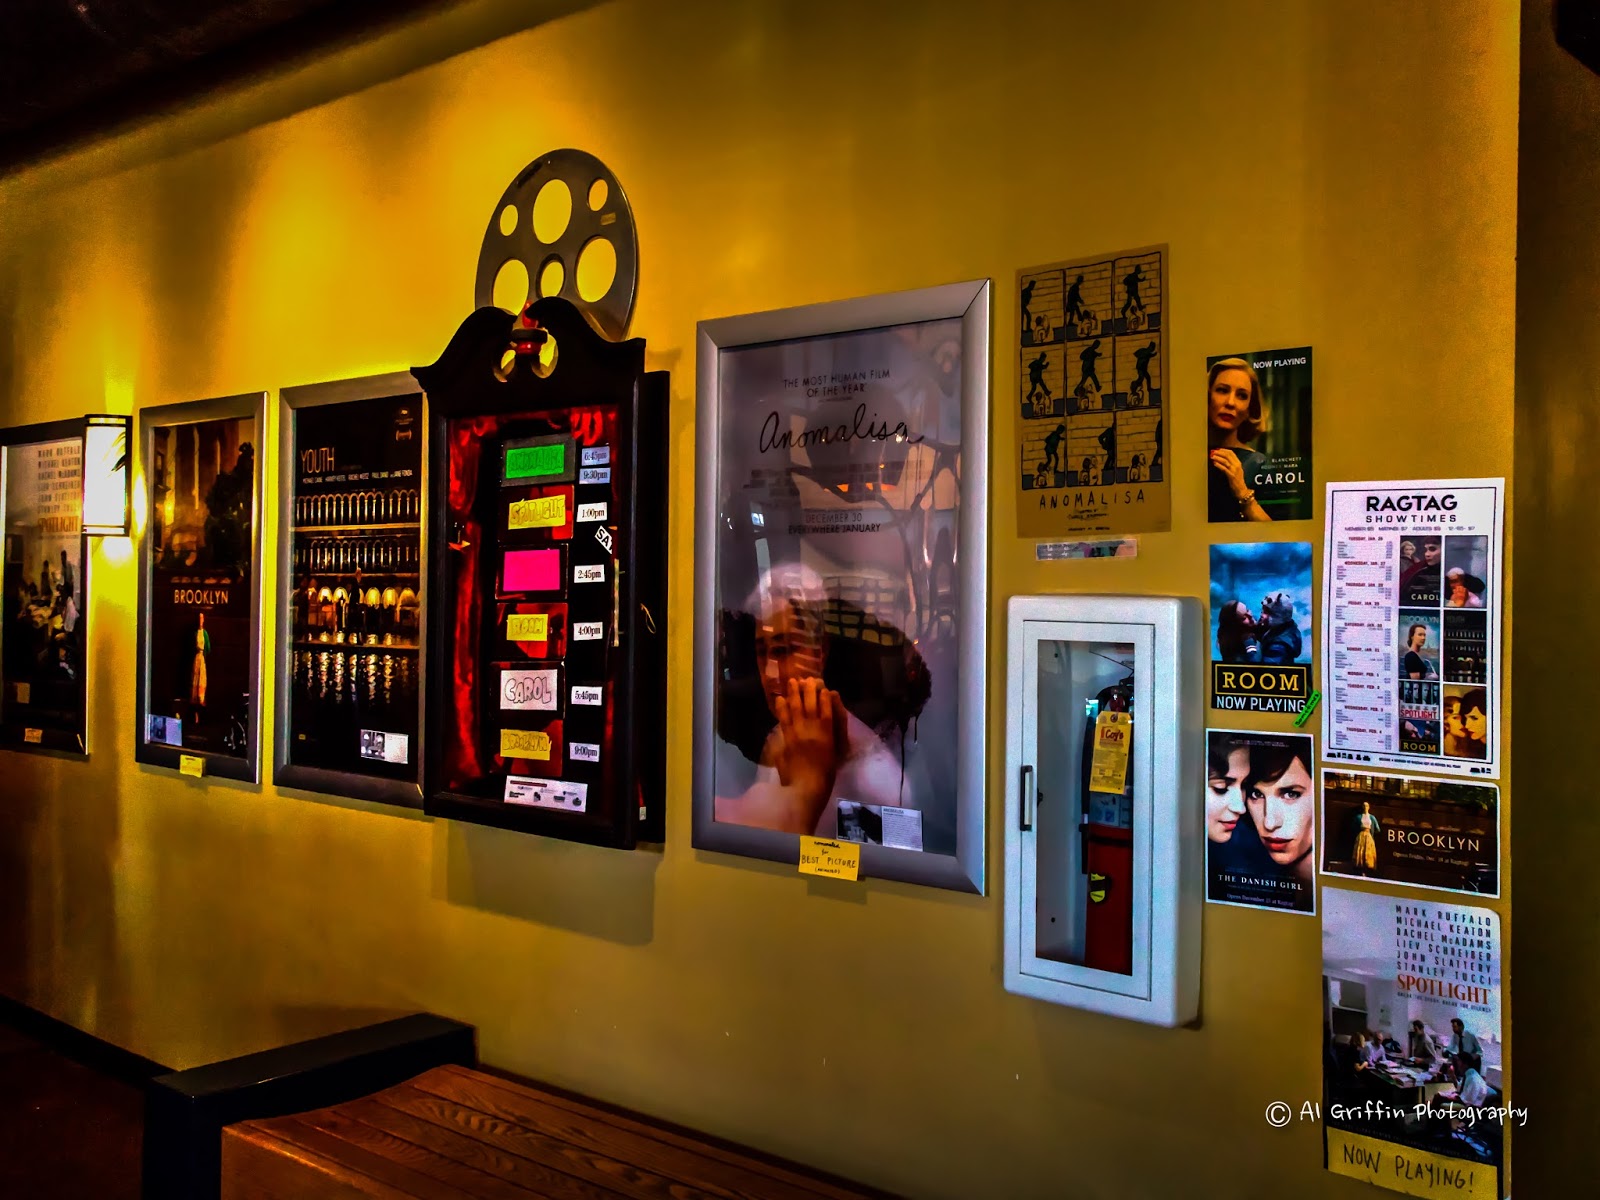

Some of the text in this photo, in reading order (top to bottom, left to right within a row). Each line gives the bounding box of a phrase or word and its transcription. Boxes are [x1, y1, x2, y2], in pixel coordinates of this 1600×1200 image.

[1253, 357, 1306, 369] NOW PLAYING
[784, 370, 890, 388] THE MOST HUMAN FILM
[806, 383, 865, 397] OF THE YEAR
[760, 403, 924, 454] Anomalisa
[300, 447, 334, 473] YOUTH
[584, 451, 607, 461] 6:45pm
[583, 470, 608, 480] 9:30pm
[1254, 472, 1305, 485] CAROL
[1040, 489, 1145, 510] ANOMALISA
[1366, 494, 1458, 512] RAGTAG
[806, 513, 862, 524] DECEMBER 30
[1366, 514, 1457, 523] SHOWTIMES
[842, 524, 880, 533] JANUARY
[596, 528, 612, 551] SA
[578, 570, 602, 580] 2:45pm
[174, 589, 229, 604] BROOKLYN
[578, 626, 600, 636] 4:00pm
[1222, 672, 1299, 691] ROOM
[505, 677, 552, 704] CAROL
[575, 690, 599, 701] 5:45pm
[1216, 696, 1247, 709] NOW
[1250, 697, 1306, 712] PLAYING
[1401, 709, 1437, 719] SPOTLIGHT
[574, 745, 598, 757] 9:00pm
[1403, 742, 1436, 752] ROOM
[1387, 829, 1480, 852] BROOKLYN
[801, 855, 856, 869] BEST PICTURE
[1218, 874, 1236, 882] THE
[1242, 876, 1276, 887] DANISH
[1280, 882, 1303, 890] GIRL
[1396, 904, 1491, 926] MARK RUFFALO
[1396, 916, 1491, 938] MICHAEL KEATON
[1396, 927, 1491, 950] RACHEL McADAMS
[1397, 939, 1491, 962] LIEV SCHREIBER
[1397, 950, 1491, 973] JOHN SLATTERY
[1397, 961, 1491, 985] STANLEY TUCCI
[1397, 973, 1491, 1004] SPOTLIGHT
[1344, 1144, 1474, 1193] NOW PLAYING!
